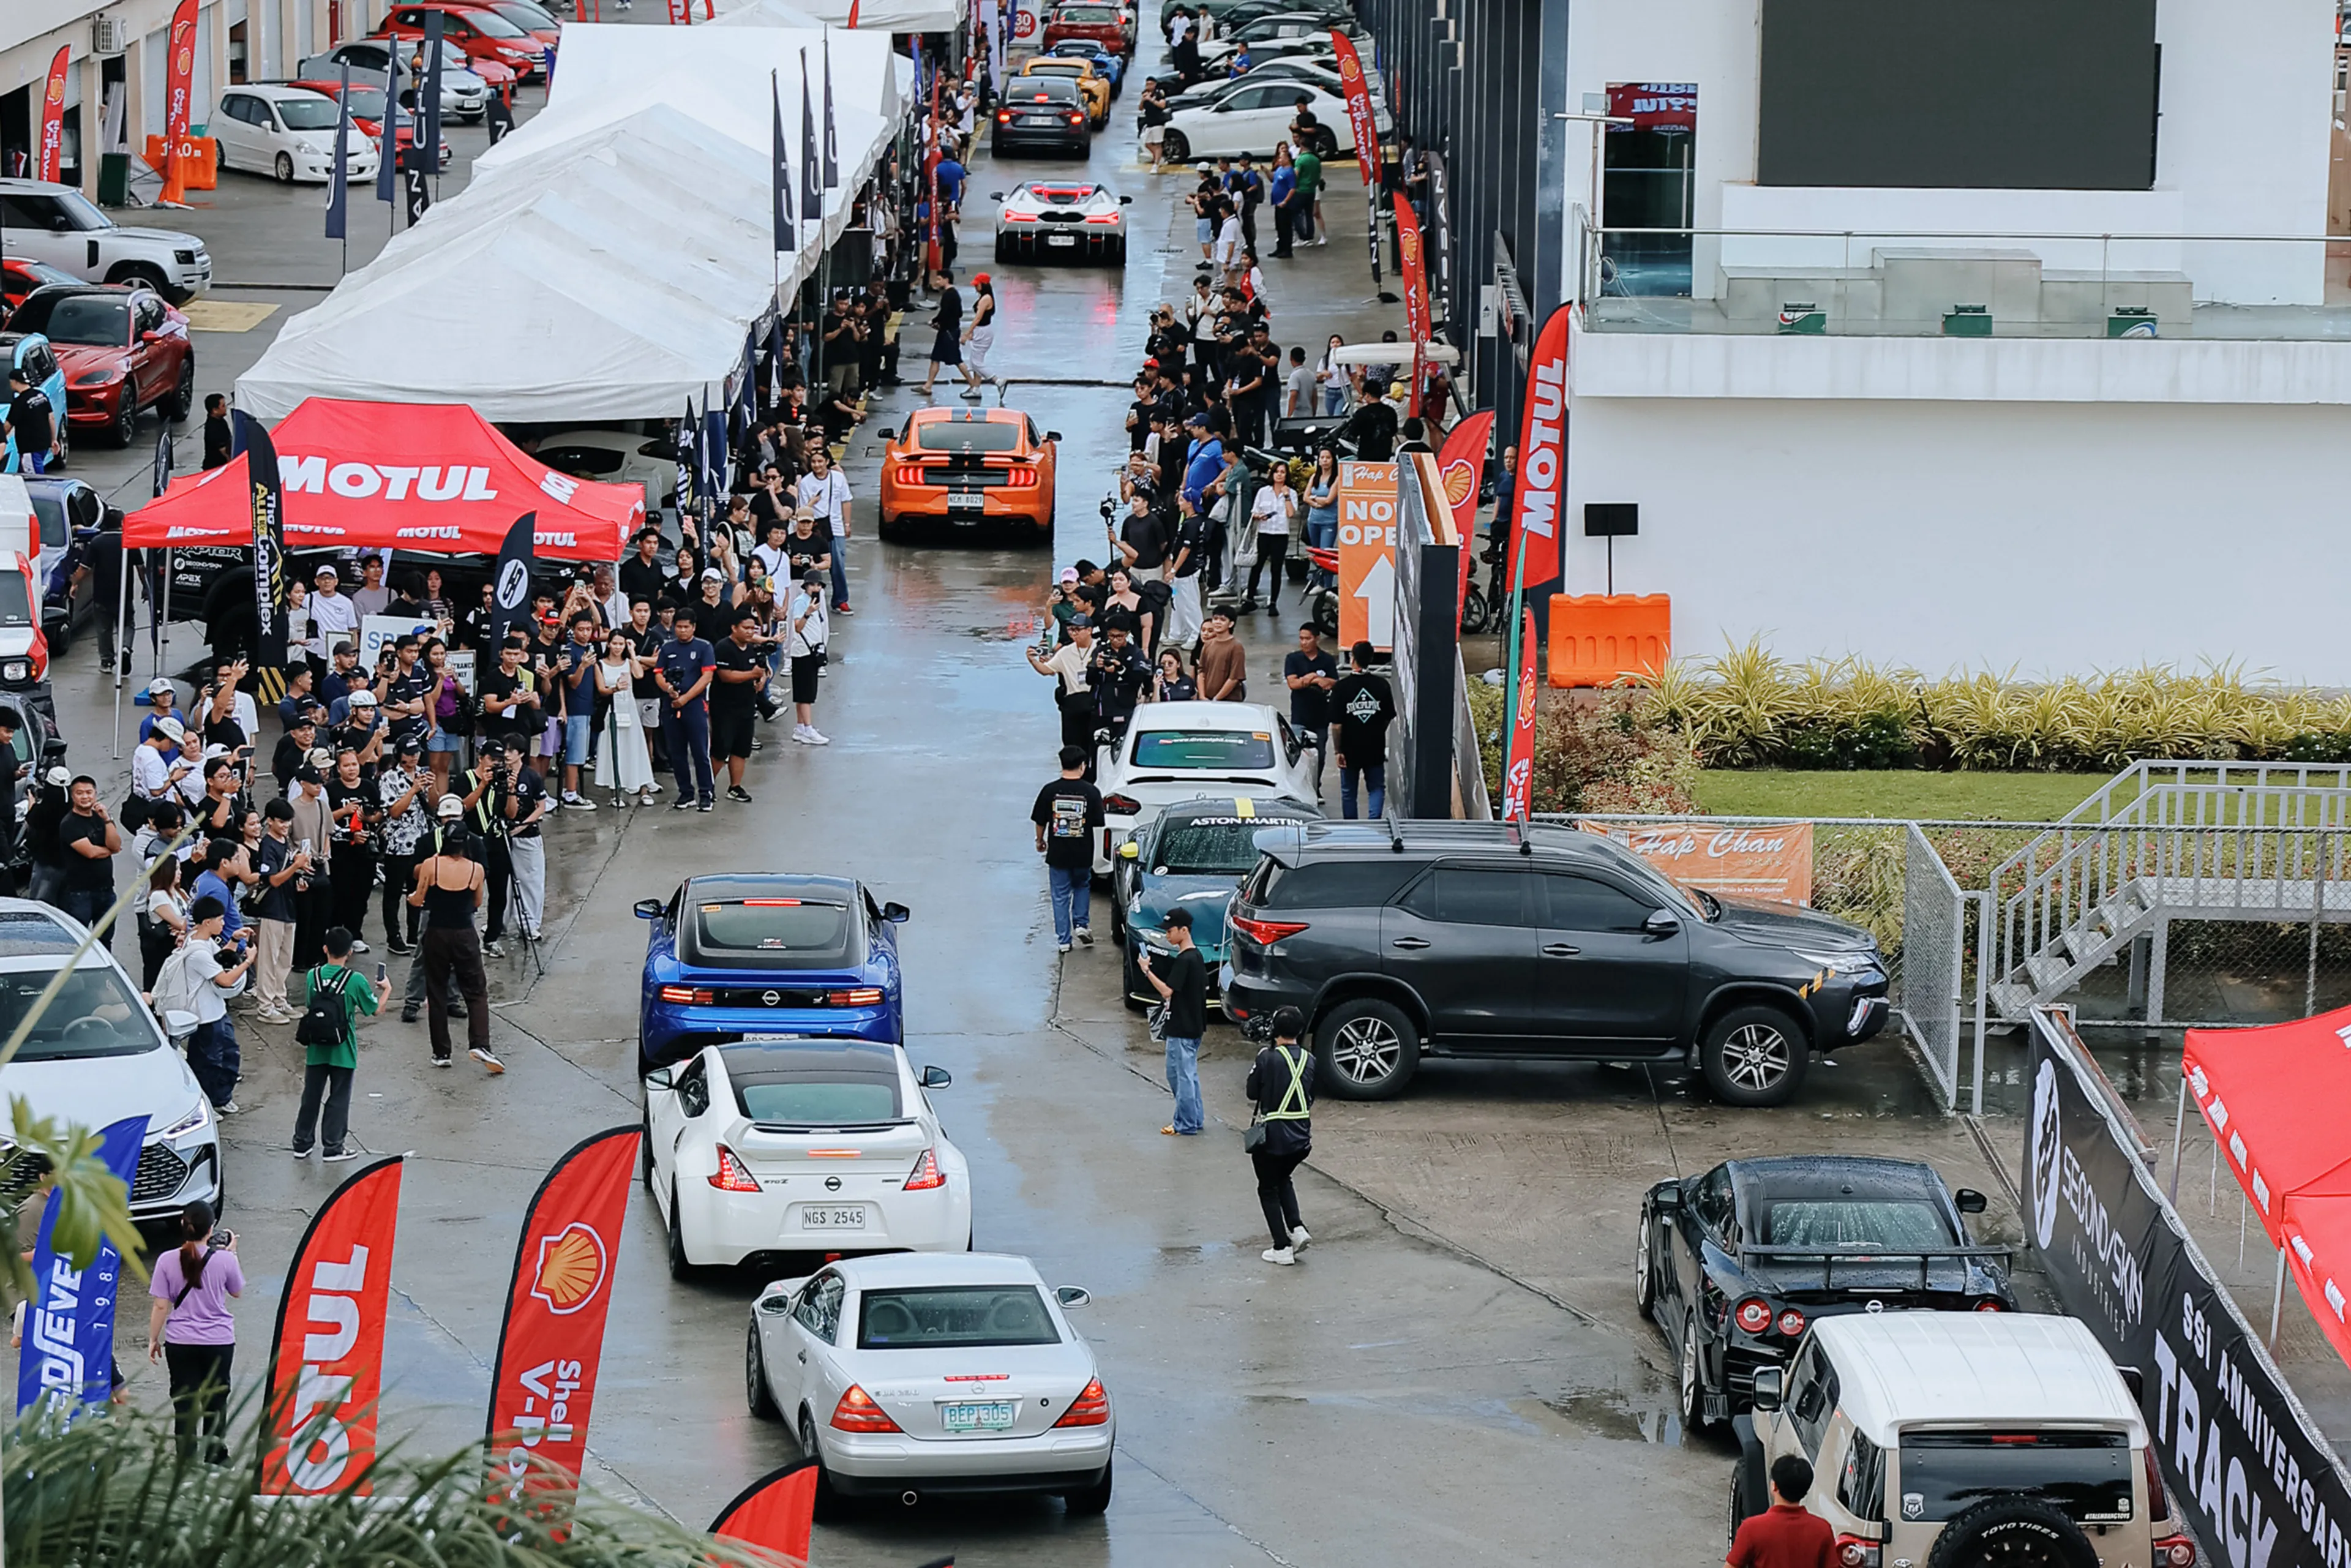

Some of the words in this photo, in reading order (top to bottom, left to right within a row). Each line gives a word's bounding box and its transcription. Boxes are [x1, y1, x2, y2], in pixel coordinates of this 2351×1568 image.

[1015, 13, 1031, 26] 30
[1521, 358, 1564, 539] MOTUL
[277, 455, 498, 501] MOTUL
[1347, 500, 1398, 521] NO
[396, 526, 462, 539] MOTUL
[533, 531, 577, 547] OTUL
[1339, 525, 1397, 547] OPE
[174, 546, 244, 562] RAPTOR
[1515, 758, 1529, 813] Shell
[1190, 817, 1241, 826] ASTON
[1631, 830, 1697, 861] Hap
[1707, 828, 1785, 858] Chan
[804, 1212, 827, 1224] NGS
[834, 1211, 863, 1224] 2545
[93, 1246, 116, 1336] 1987
[2183, 1292, 2211, 1371] SSI
[286, 1244, 370, 1491] OTUL
[547, 1359, 583, 1442] Shell
[949, 1408, 975, 1423] BEP
[982, 1406, 1009, 1422] 305
[2154, 1328, 2279, 1568] TRACK
[1980, 1521, 2017, 1539] TOYO
[2019, 1521, 2060, 1540] TIRES
